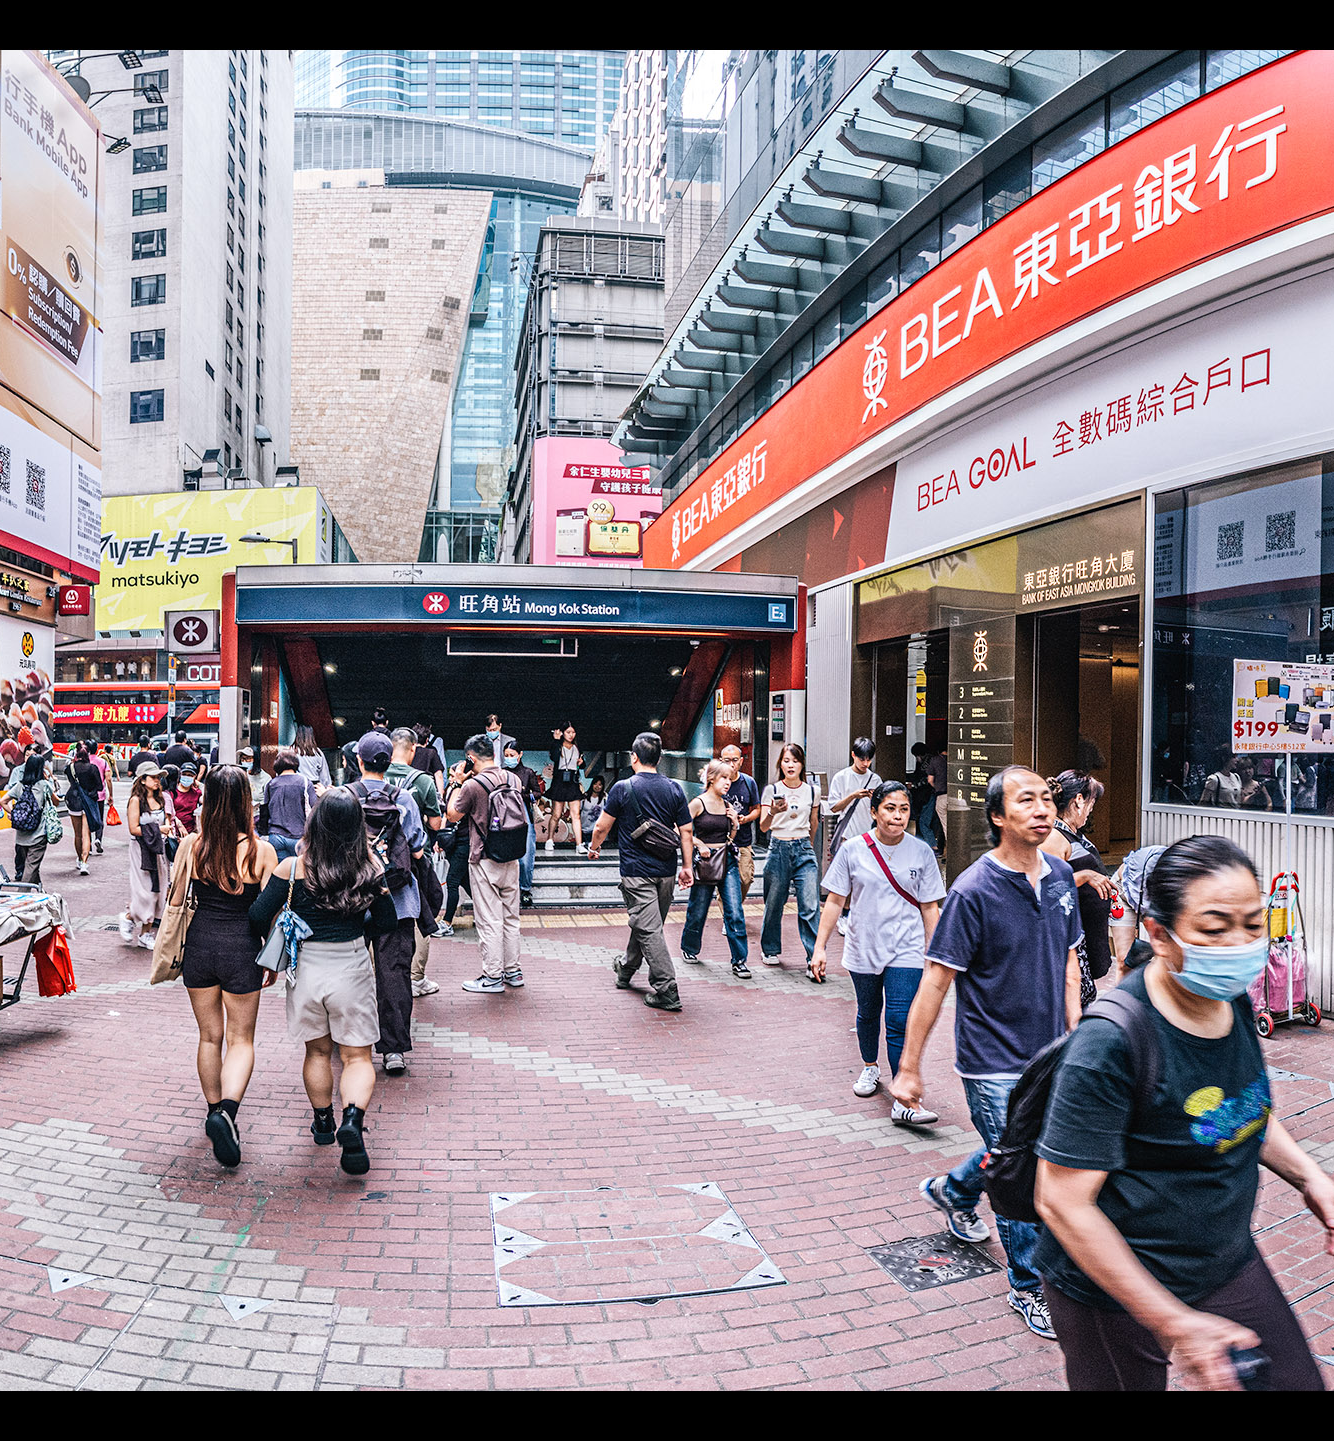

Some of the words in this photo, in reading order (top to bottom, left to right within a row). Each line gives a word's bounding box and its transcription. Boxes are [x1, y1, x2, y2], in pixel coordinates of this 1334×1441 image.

[5, 98, 33, 139] Bank
[36, 130, 69, 176] Mobile
[71, 169, 88, 198] App
[57, 128, 87, 175] App
[1010, 104, 1288, 311] 東亞銀行
[28, 286, 73, 335] Subscription/
[900, 268, 1004, 381] BEA
[28, 306, 67, 349] Redemption
[67, 339, 79, 359] Fee
[1051, 347, 1272, 458] 全數碼綜合戶口
[569, 465, 650, 480] 余仁生嬰幼兒三寶
[710, 439, 767, 520] 東亞銀行
[917, 471, 960, 513] BEA
[968, 444, 1037, 490] GOAL
[681, 490, 710, 544] BEA
[111, 570, 200, 589] matsukiyo
[1023, 549, 1135, 592] 東亞銀行旺角大廈
[458, 593, 521, 614] 旺角站
[1022, 593, 1037, 605] BANK
[1037, 591, 1045, 602] OF
[1045, 587, 1060, 600] EAST
[1060, 585, 1074, 598] ASIA
[1074, 578, 1105, 596] MONGKOK
[1105, 573, 1136, 590] BUILDING
[524, 602, 557, 618] Mong
[559, 603, 579, 615] Kok
[580, 603, 620, 616] Station
[771, 606, 785, 620] E2
[959, 686, 965, 699] 3
[959, 707, 965, 719] 2
[959, 728, 963, 740] 1
[1234, 720, 1279, 739] $199
[957, 748, 965, 761] M
[957, 768, 964, 781] G
